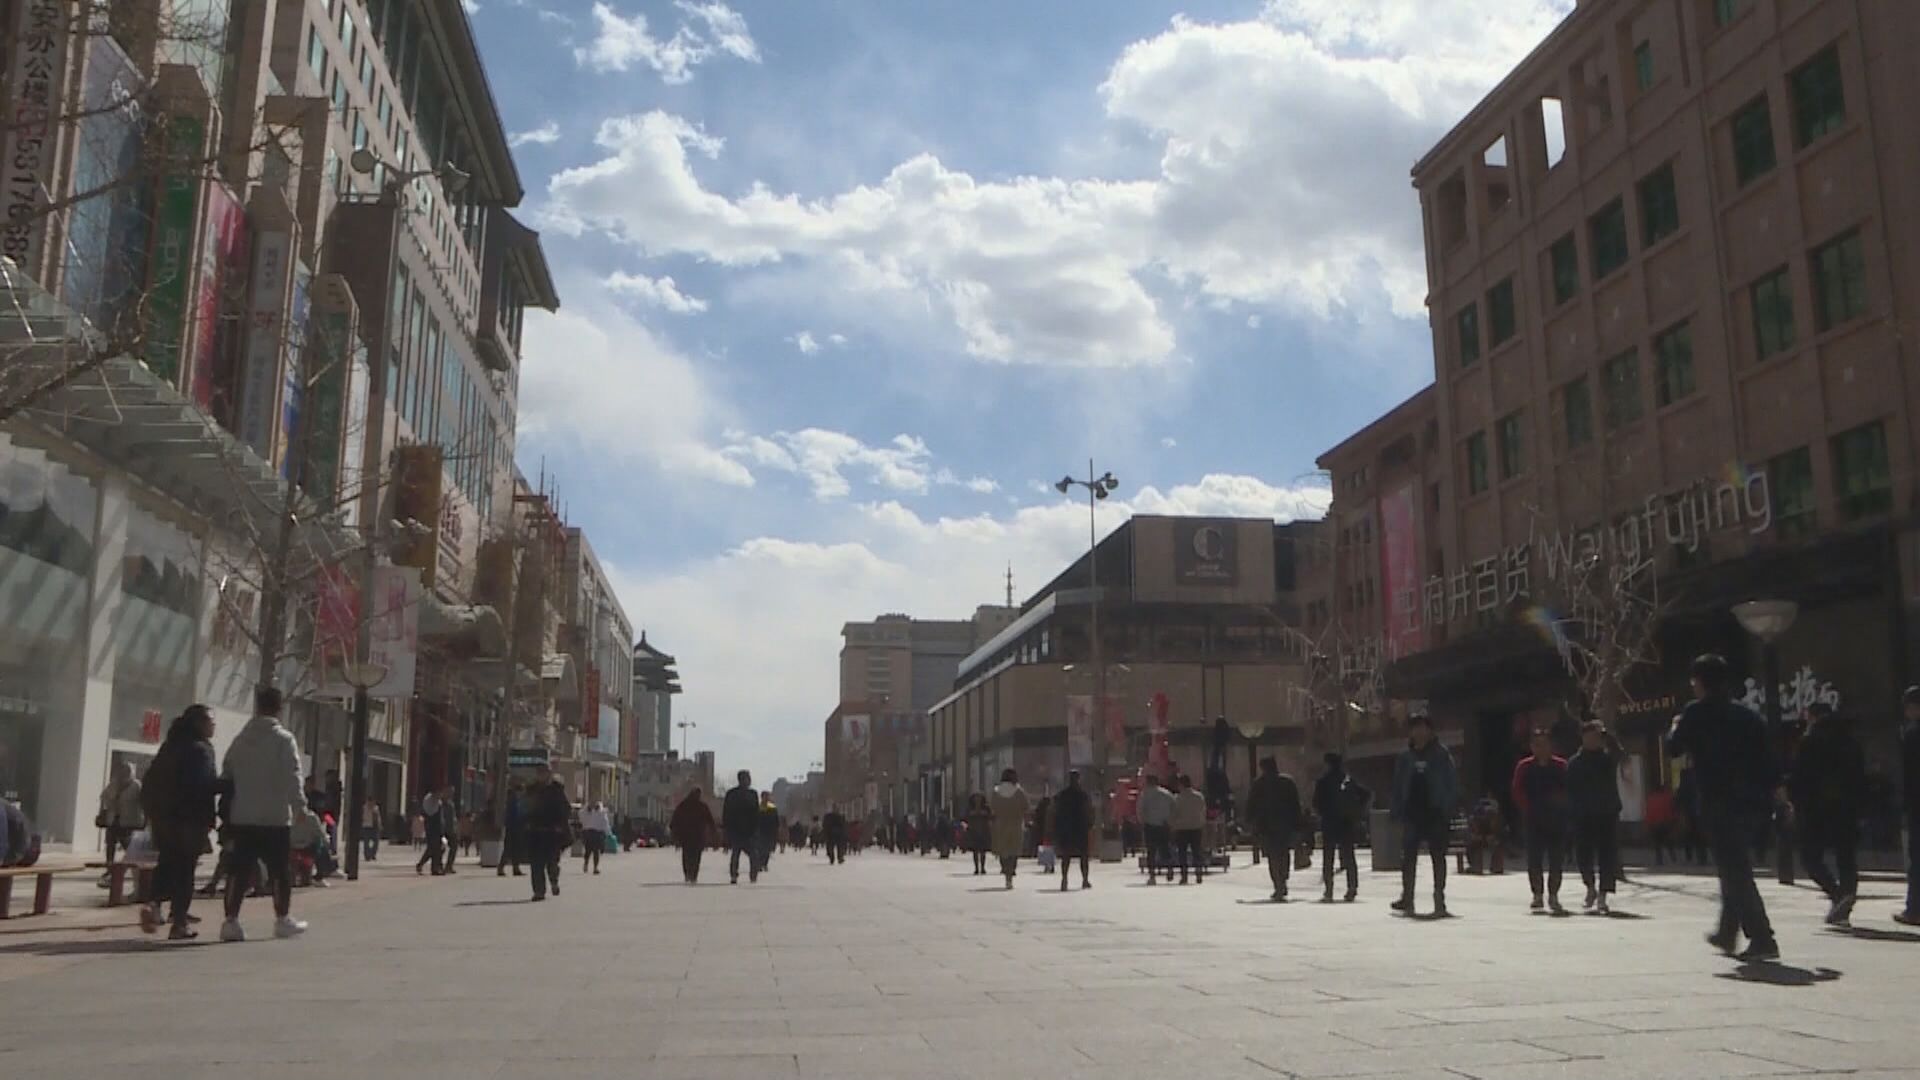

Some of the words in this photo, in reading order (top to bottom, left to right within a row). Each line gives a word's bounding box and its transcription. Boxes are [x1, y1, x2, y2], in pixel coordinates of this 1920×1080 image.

[1402, 543, 1531, 637] 王府井百货
